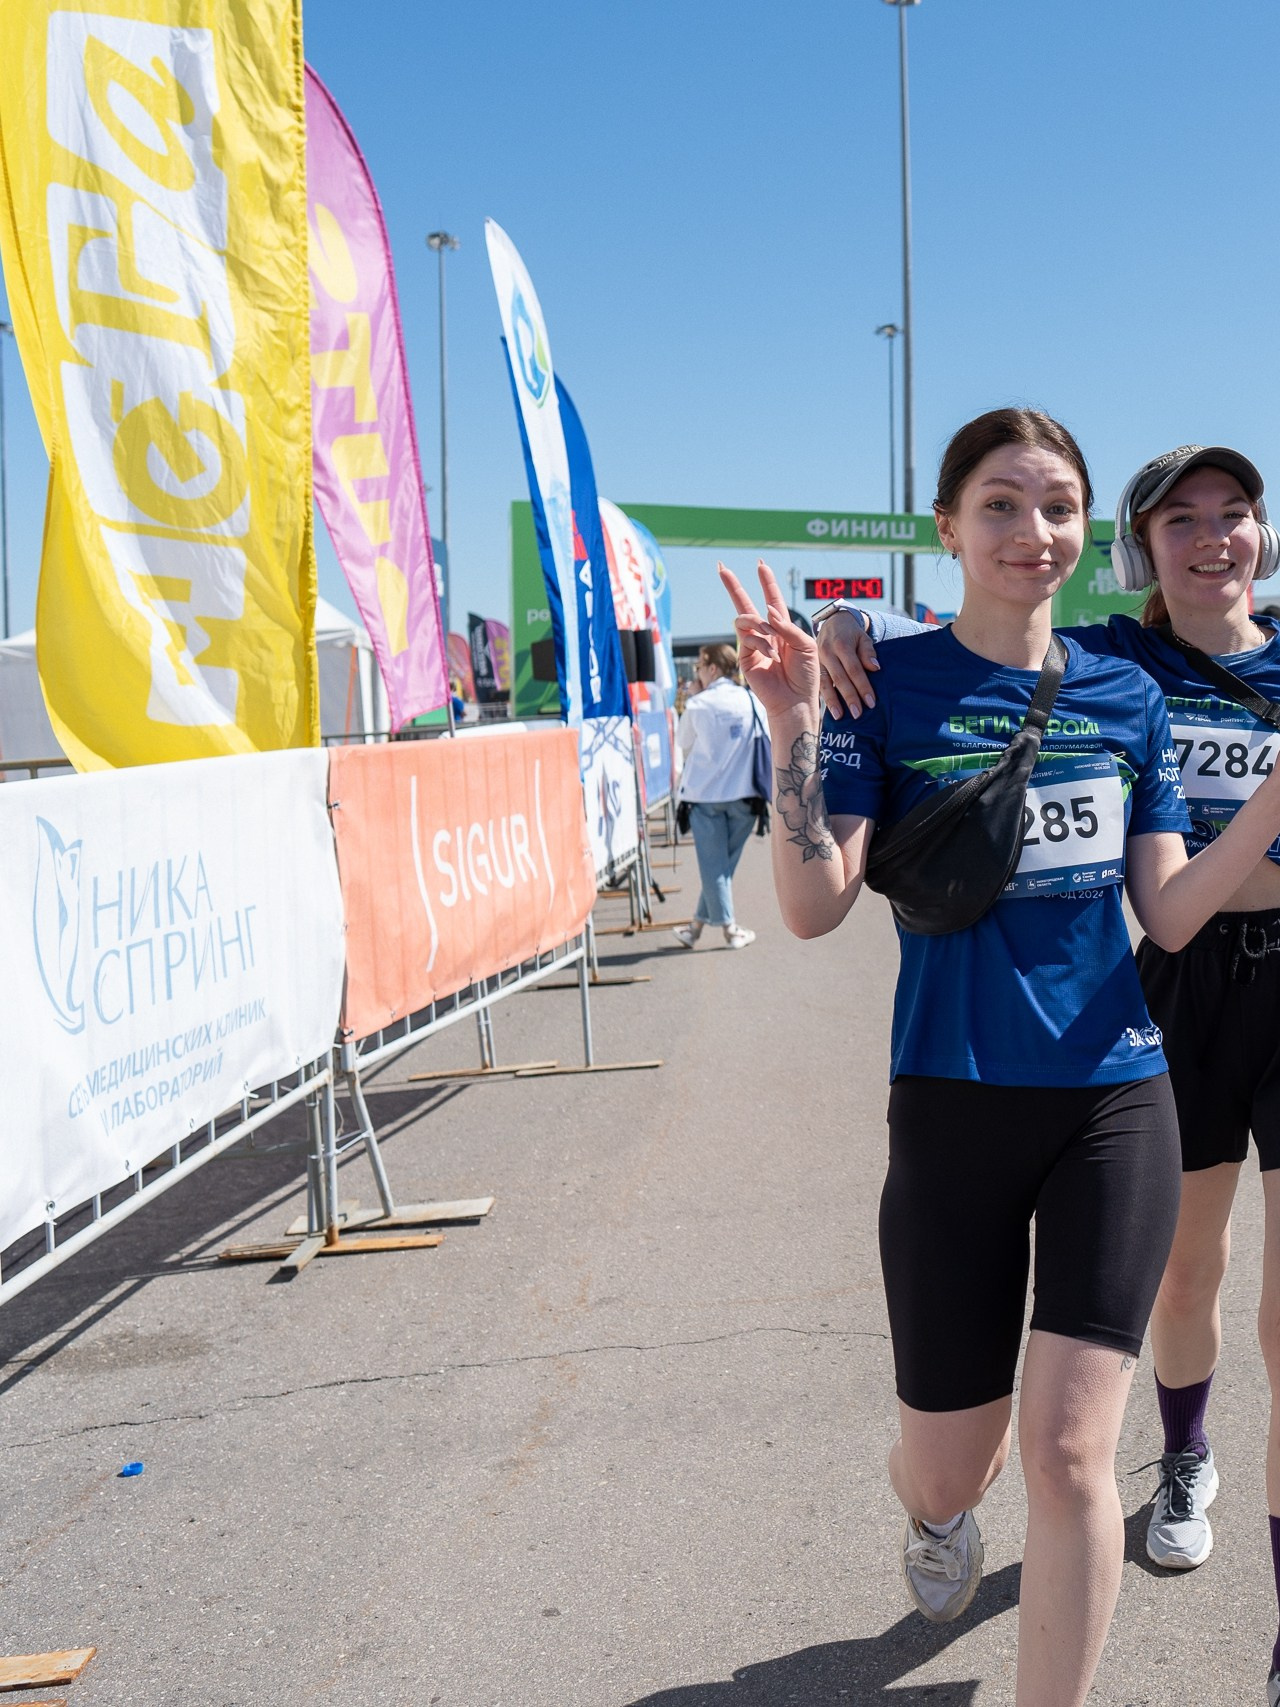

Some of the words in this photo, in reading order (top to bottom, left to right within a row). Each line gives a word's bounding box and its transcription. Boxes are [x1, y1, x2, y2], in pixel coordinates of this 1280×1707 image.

[806, 518, 916, 539] ФИНИШ
[1175, 739, 1274, 779] 7284
[1023, 795, 1099, 847] 285
[433, 813, 539, 907] SIGUR
[93, 850, 214, 949] НИКА
[93, 904, 257, 1025] СПРИНГ
[216, 997, 267, 1041] КЛИНИК
[111, 1047, 224, 1130] ЛАБОРАТОРИЙ
